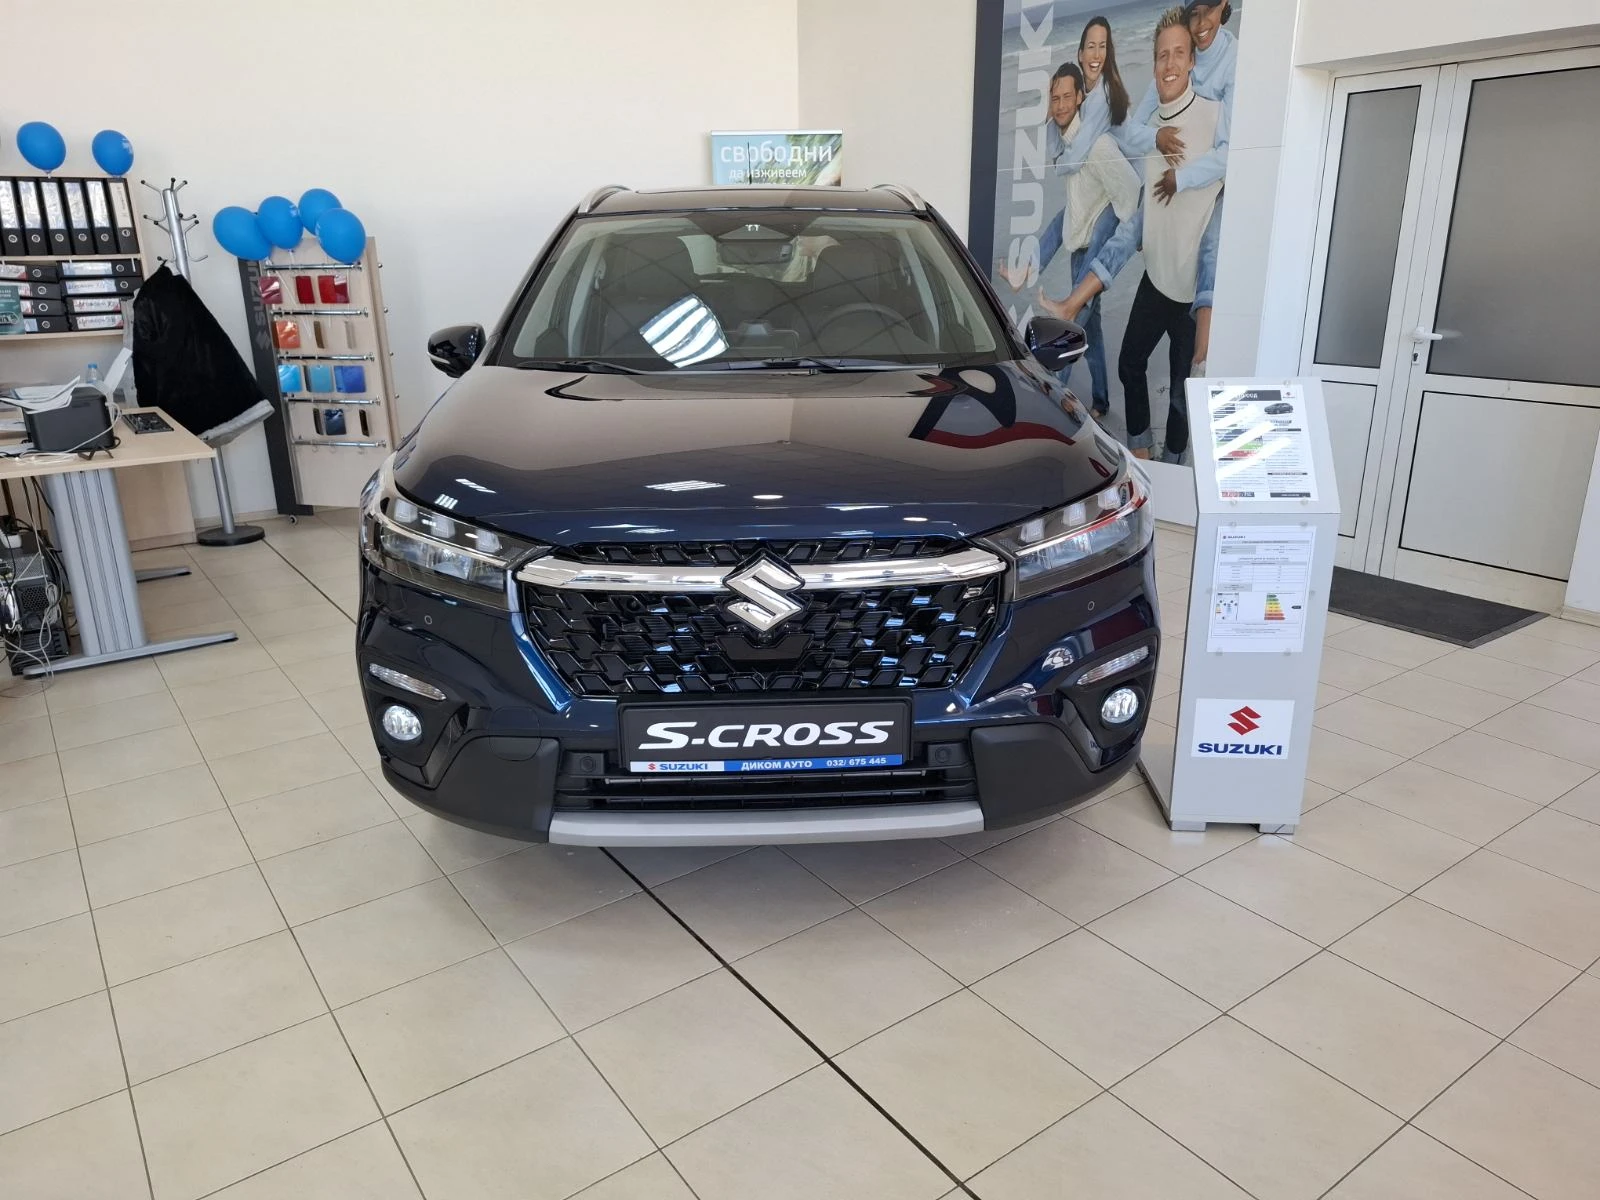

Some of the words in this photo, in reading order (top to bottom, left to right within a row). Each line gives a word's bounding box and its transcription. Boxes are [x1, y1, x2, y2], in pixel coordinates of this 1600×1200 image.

[720, 141, 832, 165] свободни
[638, 720, 895, 750] S-CROSS
[1198, 742, 1283, 755] SUZUKI
[659, 762, 708, 771] SUZUKI
[741, 760, 782, 772] ДИКОМ
[783, 760, 813, 769] АУТО
[826, 758, 847, 768] 032/
[849, 757, 867, 767] 675
[869, 757, 888, 766] 445
